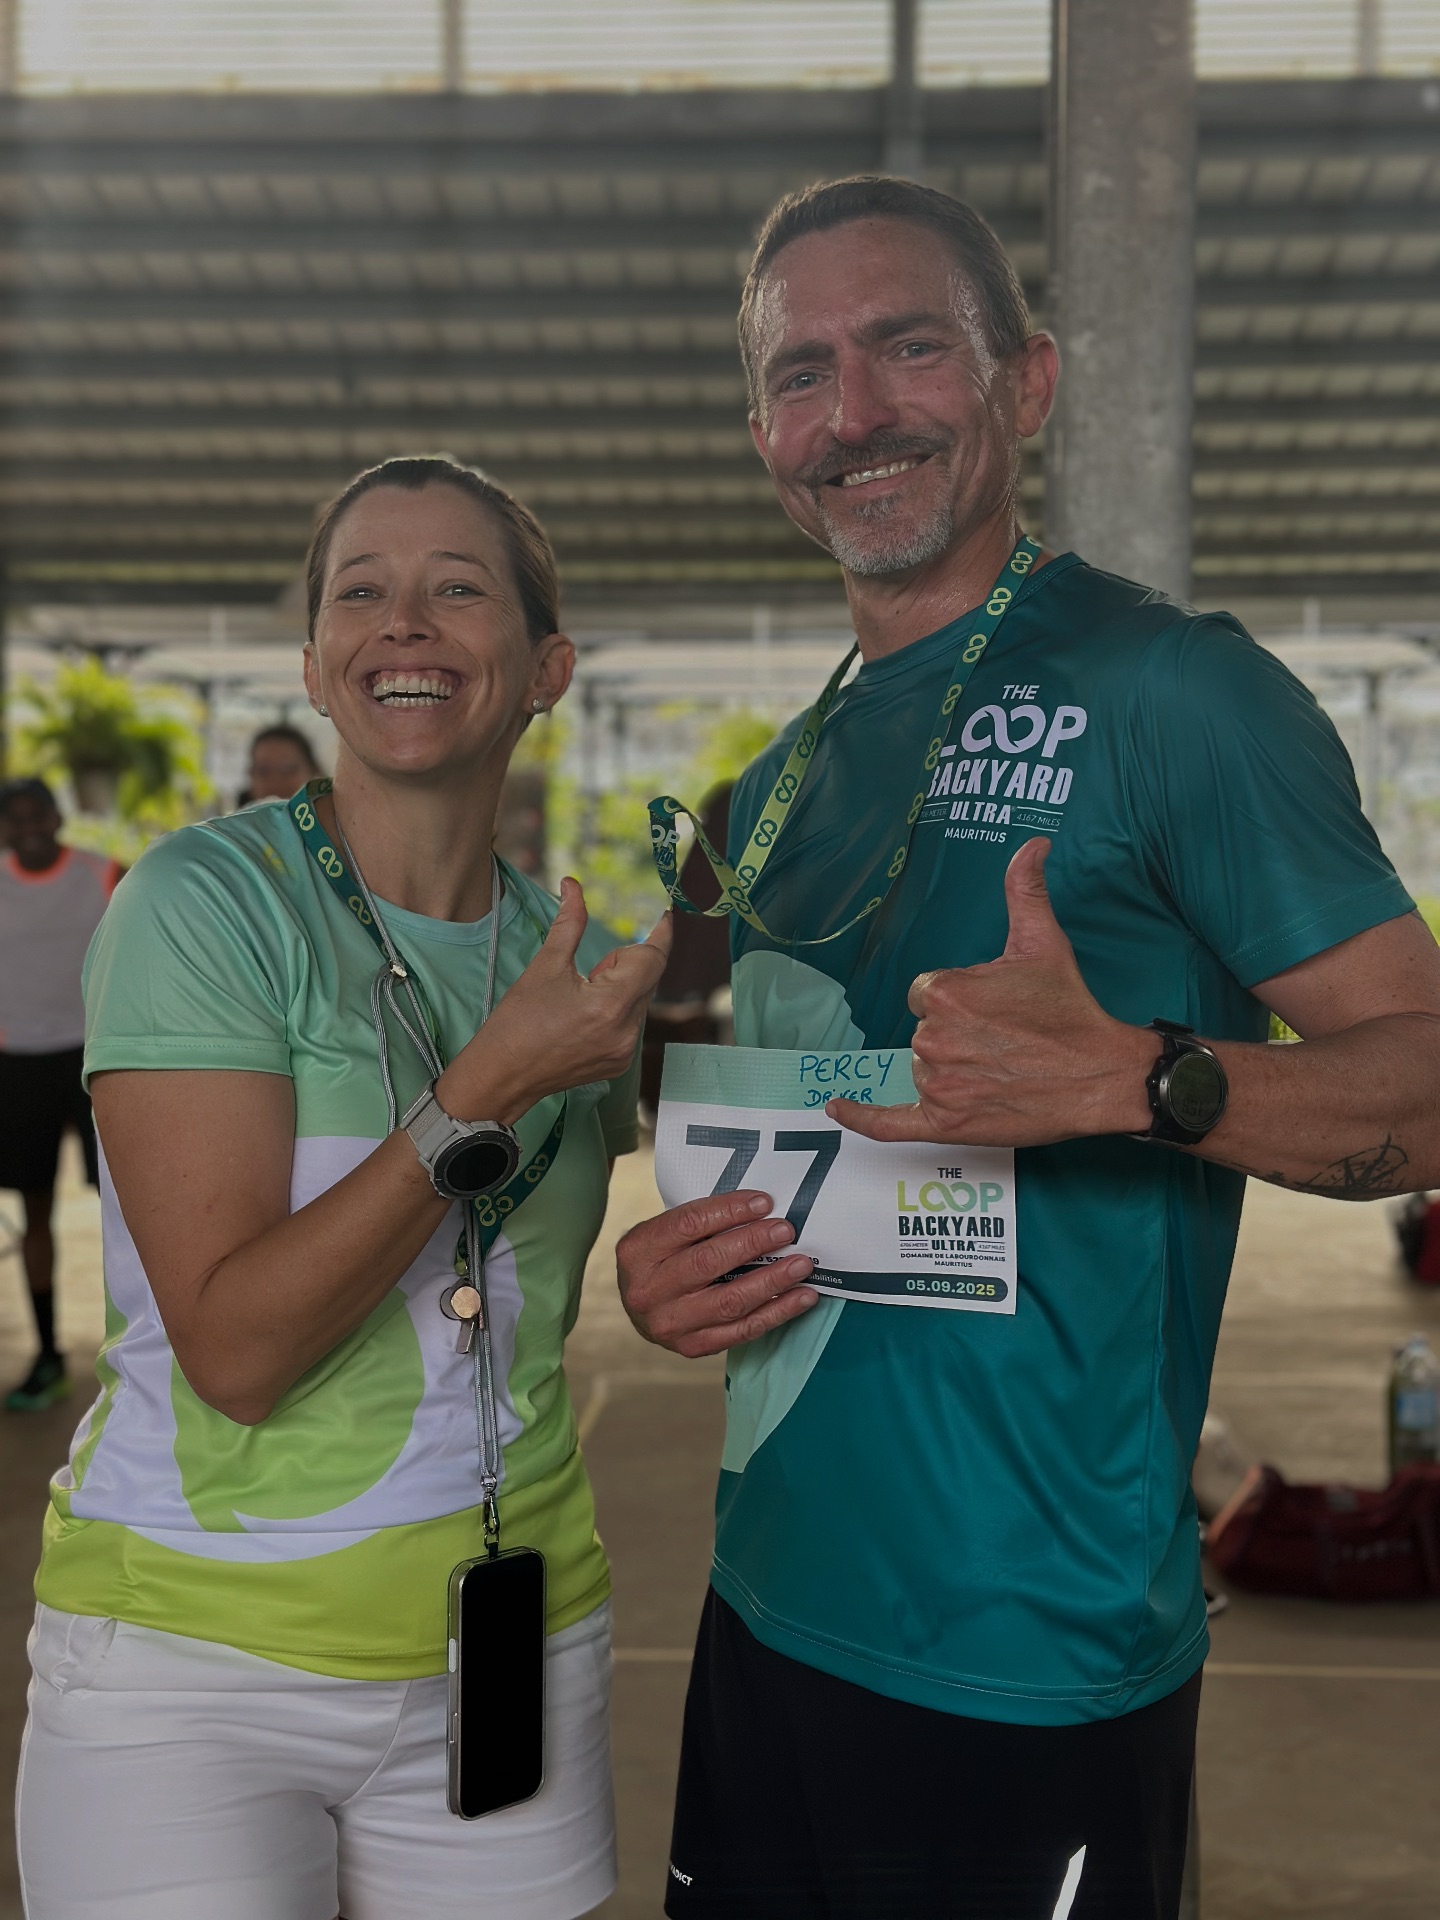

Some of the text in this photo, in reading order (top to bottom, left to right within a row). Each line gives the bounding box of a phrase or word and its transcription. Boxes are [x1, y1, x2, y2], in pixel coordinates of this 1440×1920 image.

[1002, 685, 1040, 700] THE
[1016, 813, 1061, 827] 4167 MILES
[944, 828, 1007, 843] MAURITIUS
[799, 1052, 894, 1087] PERCY
[804, 1087, 873, 1107] DRVER
[937, 1167, 962, 1179] THE
[686, 1124, 842, 1245] 77
[897, 1180, 1004, 1213] LOOP
[898, 1215, 1005, 1238] BACKYARD
[934, 1260, 973, 1268] MAURITIUS
[945, 1253, 1006, 1262] LABOURDONNAIS
[809, 1273, 843, 1284] ibilities
[906, 1279, 996, 1296] 05.09.2025
